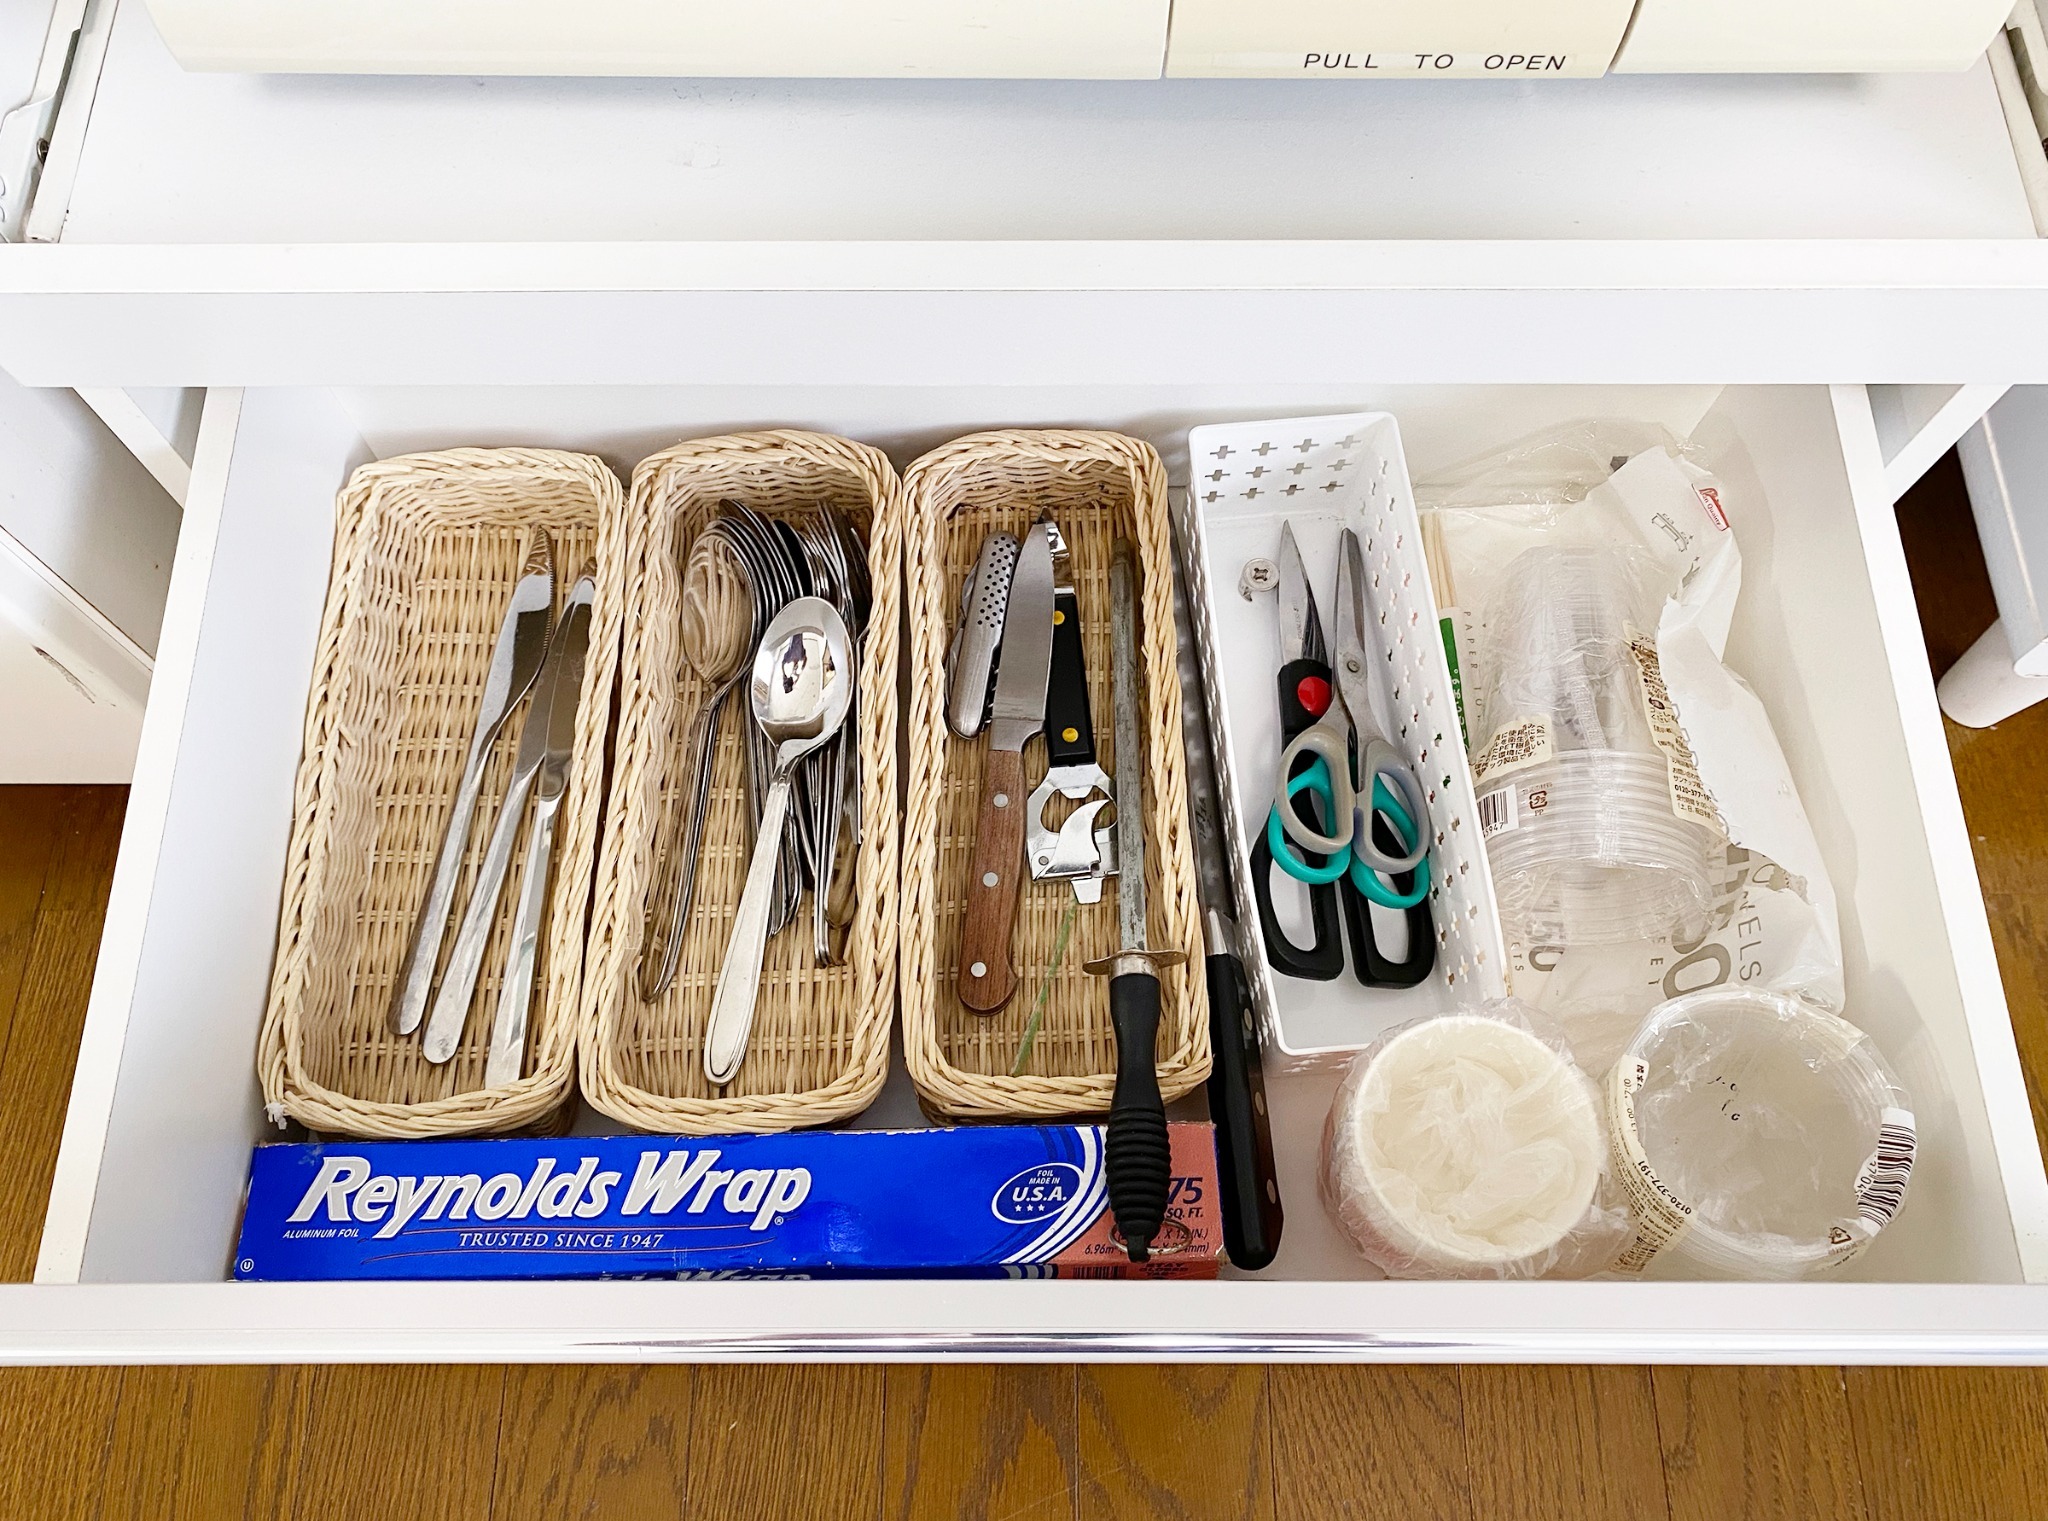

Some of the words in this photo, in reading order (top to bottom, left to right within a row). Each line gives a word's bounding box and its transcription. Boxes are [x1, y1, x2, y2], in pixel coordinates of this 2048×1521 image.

[1304, 53, 1379, 69] PULL
[1414, 54, 1454, 70] TO
[1484, 54, 1567, 71] OPEN
[1463, 611, 1478, 669] PAPER
[1028, 1177, 1051, 1185] MADE
[1051, 1177, 1061, 1185] IN
[1037, 1169, 1054, 1177] FOIL
[286, 1156, 622, 1240] Reynolds
[620, 1150, 812, 1231] Wrap
[1012, 1186, 1067, 1202] U.S.A.
[1167, 1177, 1203, 1205] 75
[1166, 1207, 1185, 1219] SQ.
[1187, 1207, 1204, 1218] FT.
[282, 1229, 336, 1239] ALUMINUM
[337, 1228, 360, 1238] FOIL
[459, 1232, 549, 1247] TRUSTED
[554, 1233, 615, 1248] SINCE
[620, 1233, 665, 1248] 1947
